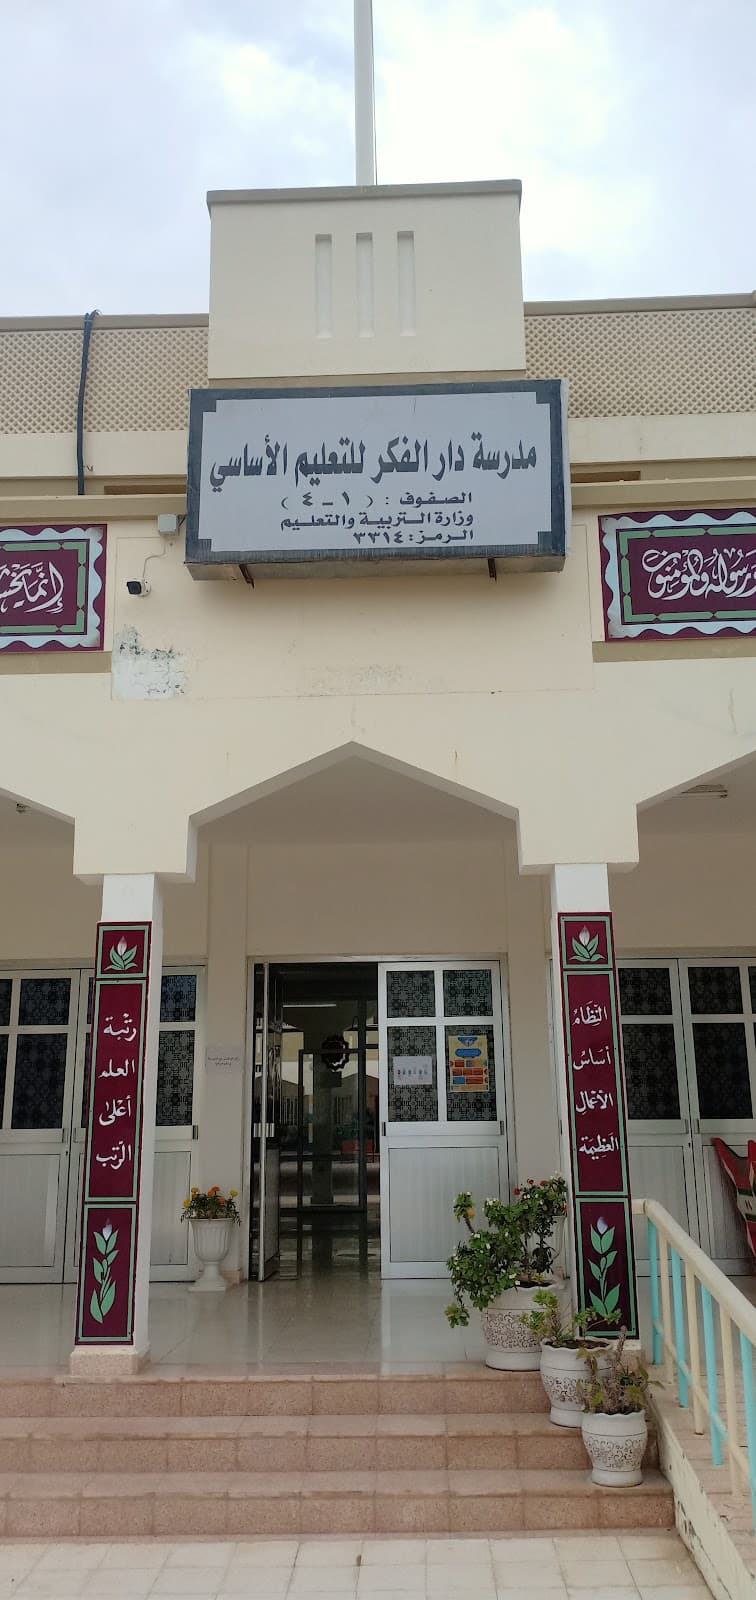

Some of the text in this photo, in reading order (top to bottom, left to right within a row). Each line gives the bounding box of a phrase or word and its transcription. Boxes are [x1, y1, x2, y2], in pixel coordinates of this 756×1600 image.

[209, 432, 537, 492] مدرسة دار الفكر للتعليم الأساسي
[400, 491, 472, 508] الصفوف
[280, 510, 474, 531] وزارة التربية والتعليم
[98, 1058, 135, 1078] العلم
